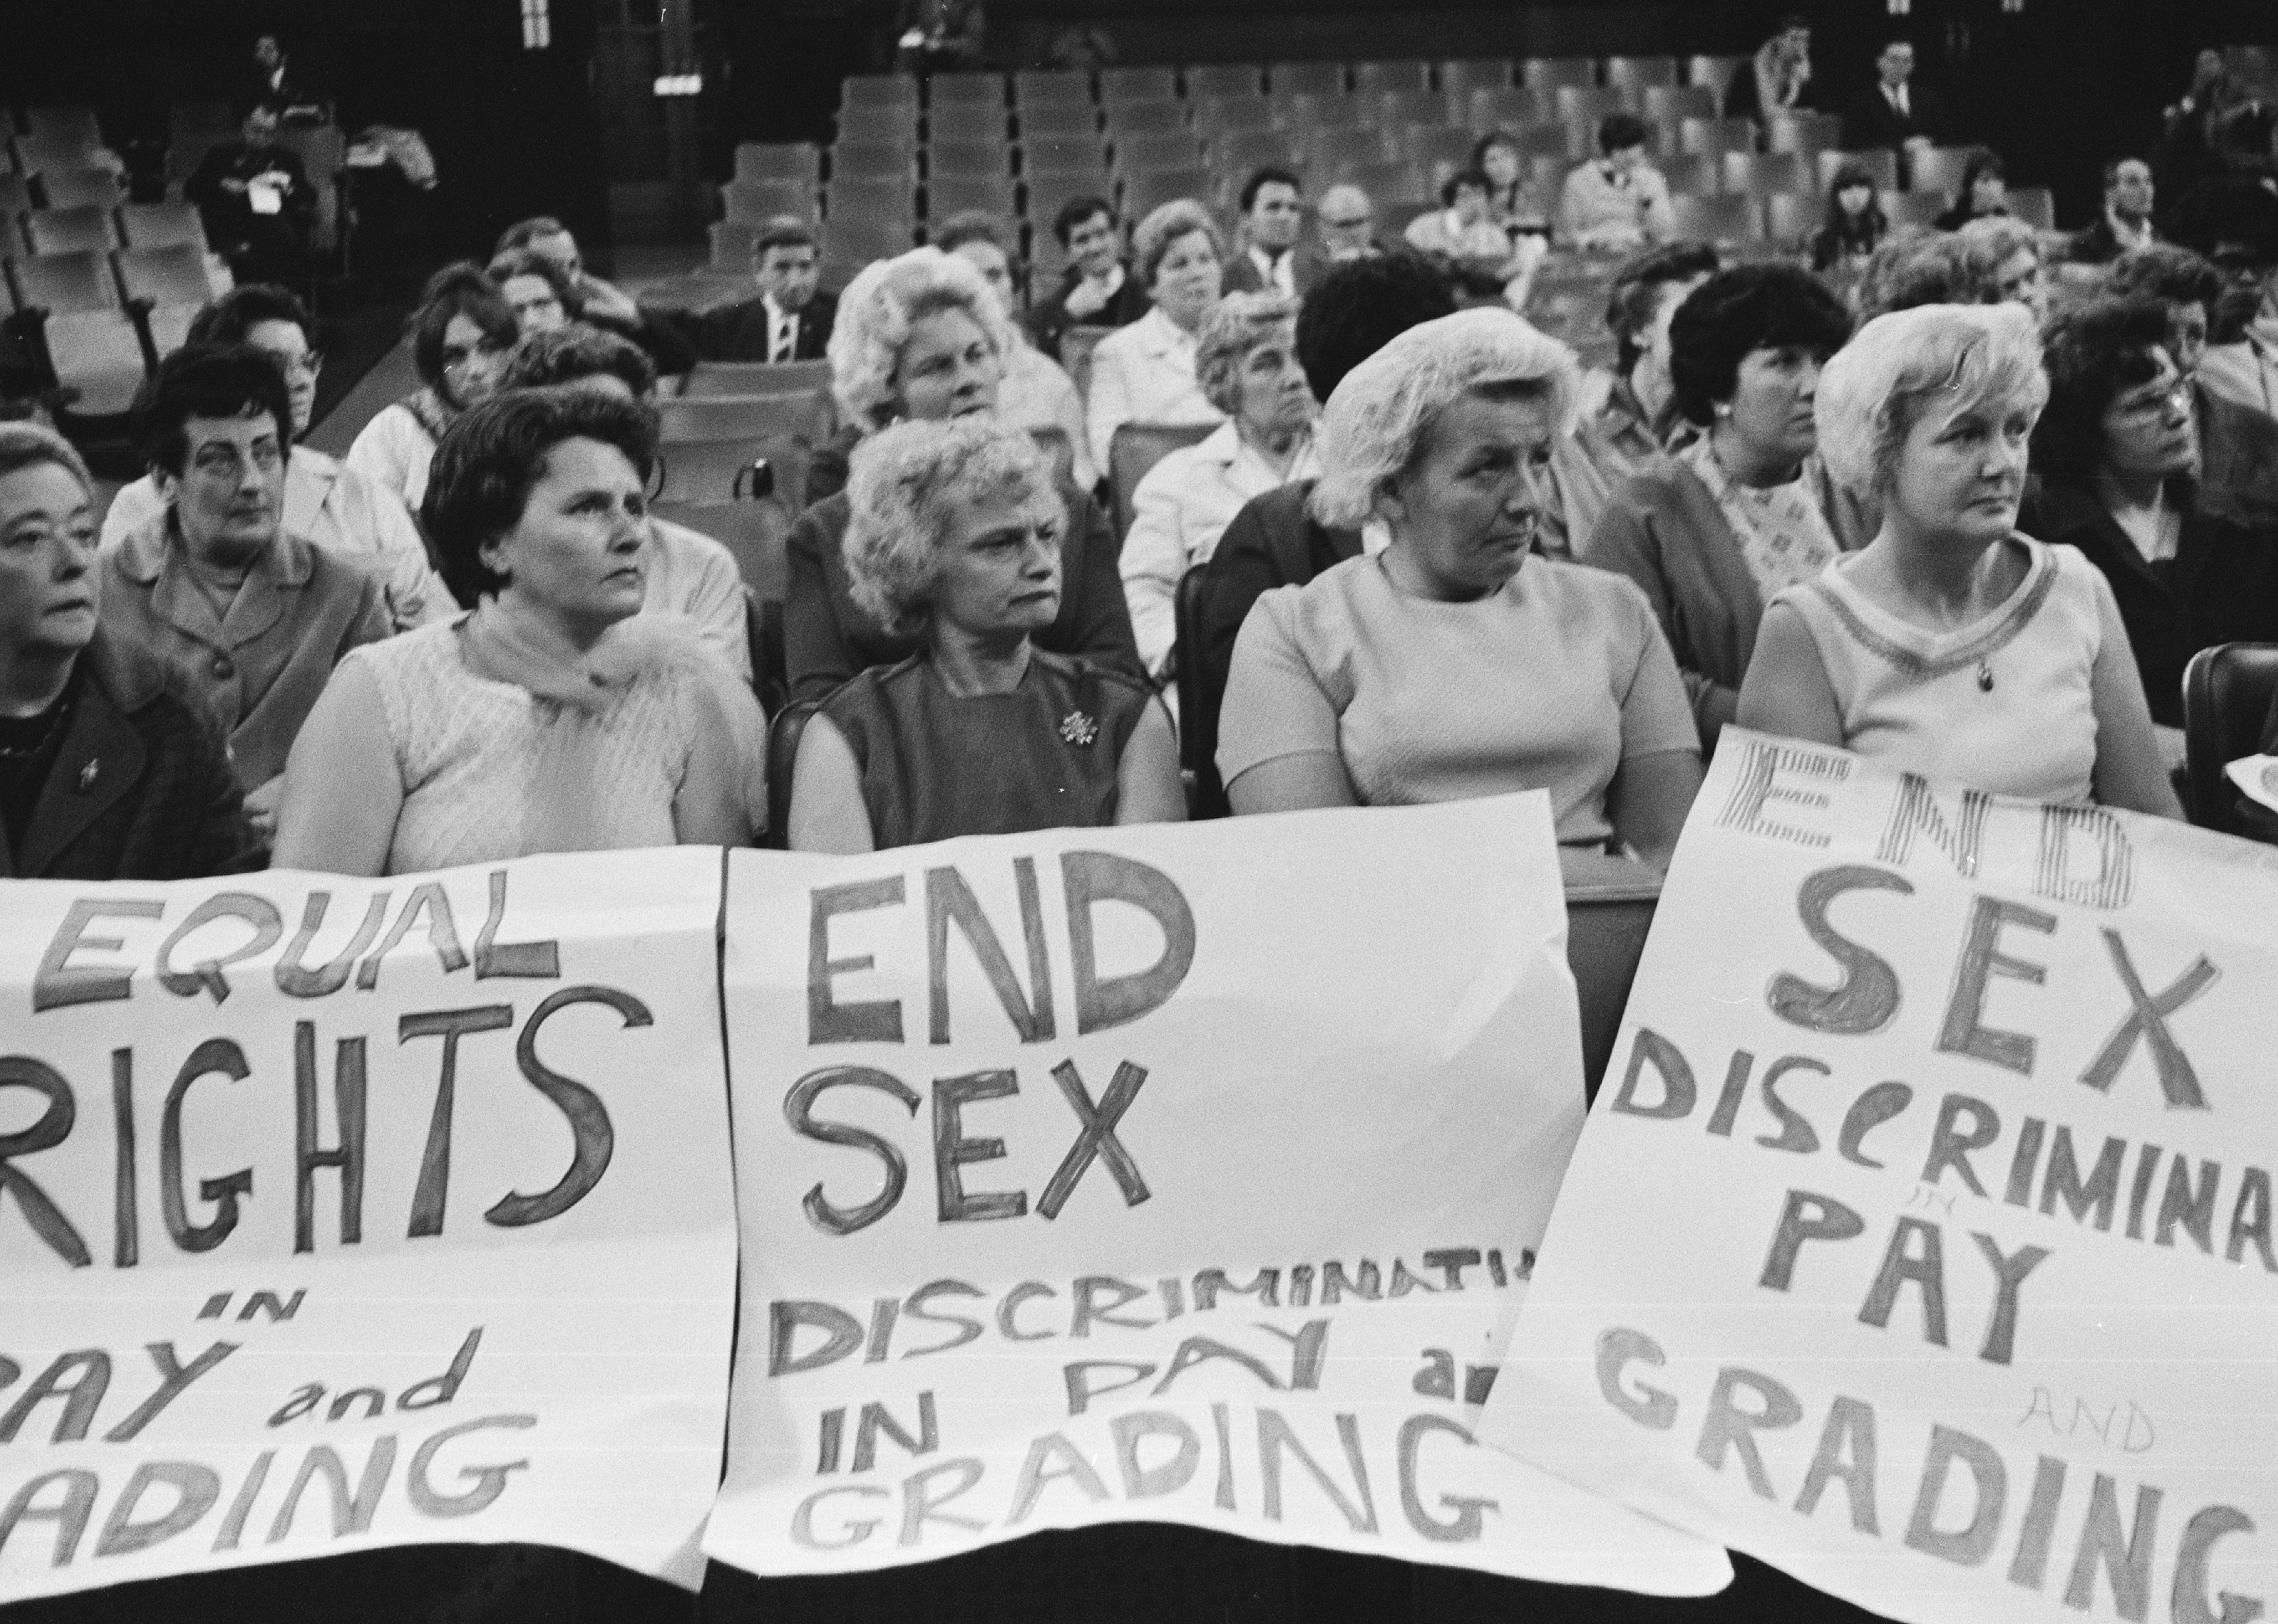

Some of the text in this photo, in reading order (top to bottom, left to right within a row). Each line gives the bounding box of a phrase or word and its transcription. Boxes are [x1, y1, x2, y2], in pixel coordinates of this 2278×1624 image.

[1712, 741, 2137, 909] END
[33, 870, 560, 1012] EQUAL
[807, 850, 1195, 1046] END
[1765, 864, 2222, 1112] SEX
[0, 986, 654, 1268] RIGHTS
[782, 1058, 1150, 1235] SEX
[1610, 1027, 2278, 1274] DISCRIMINA
[195, 1289, 308, 1321] IN
[1758, 1189, 2054, 1365] PAY
[267, 1325, 484, 1427] and
[817, 1389, 939, 1475] IN
[1063, 1319, 1331, 1415] PAY
[2016, 1386, 2155, 1452] AND
[790, 1400, 1500, 1551] GRADING
[1595, 1326, 2265, 1624] GRADING
